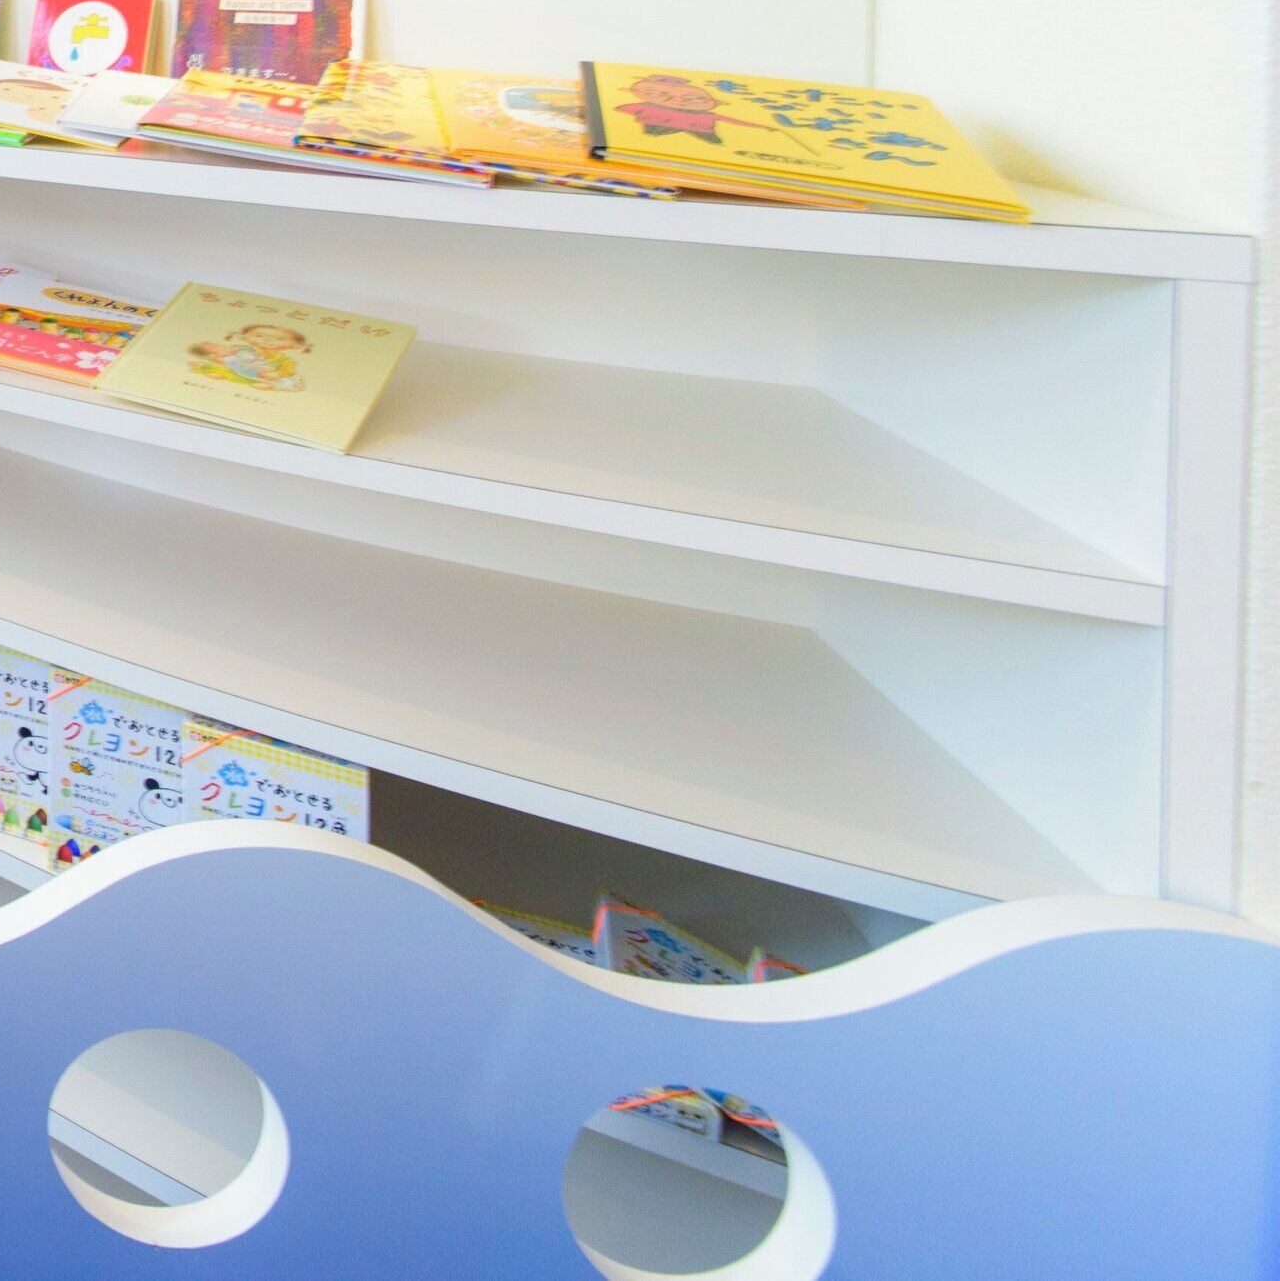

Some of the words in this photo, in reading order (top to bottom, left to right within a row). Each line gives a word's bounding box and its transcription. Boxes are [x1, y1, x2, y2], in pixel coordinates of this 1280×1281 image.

[197, 290, 393, 338] ちょっとだけ
[63, 721, 183, 769] クレヨン12
